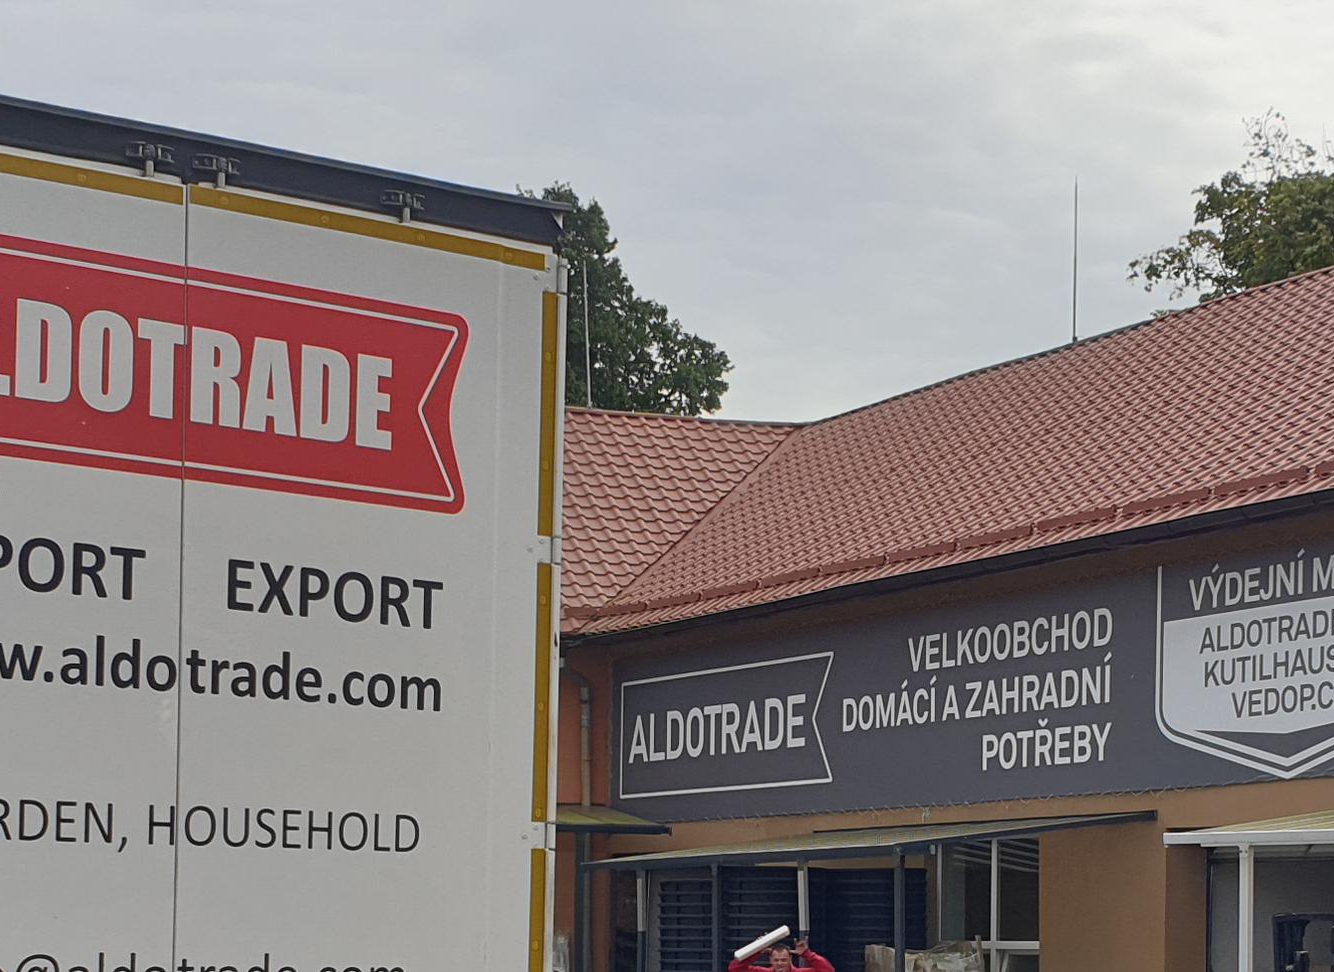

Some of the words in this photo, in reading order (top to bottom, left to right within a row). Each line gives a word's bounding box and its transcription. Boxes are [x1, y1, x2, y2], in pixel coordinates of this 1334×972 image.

[227, 558, 444, 631] EXPORT
[1188, 562, 1304, 611] VÝDEJNÍ
[908, 607, 1113, 673] VELKOOBCHOD
[842, 676, 937, 733] DOMÁCÍ
[942, 685, 960, 721] A
[965, 652, 1112, 718] ZAHRADNÍ
[628, 693, 807, 764] ALDOTRADE
[981, 718, 1112, 772] POTŘEBY
[146, 804, 421, 854] HOUSEHOLD
